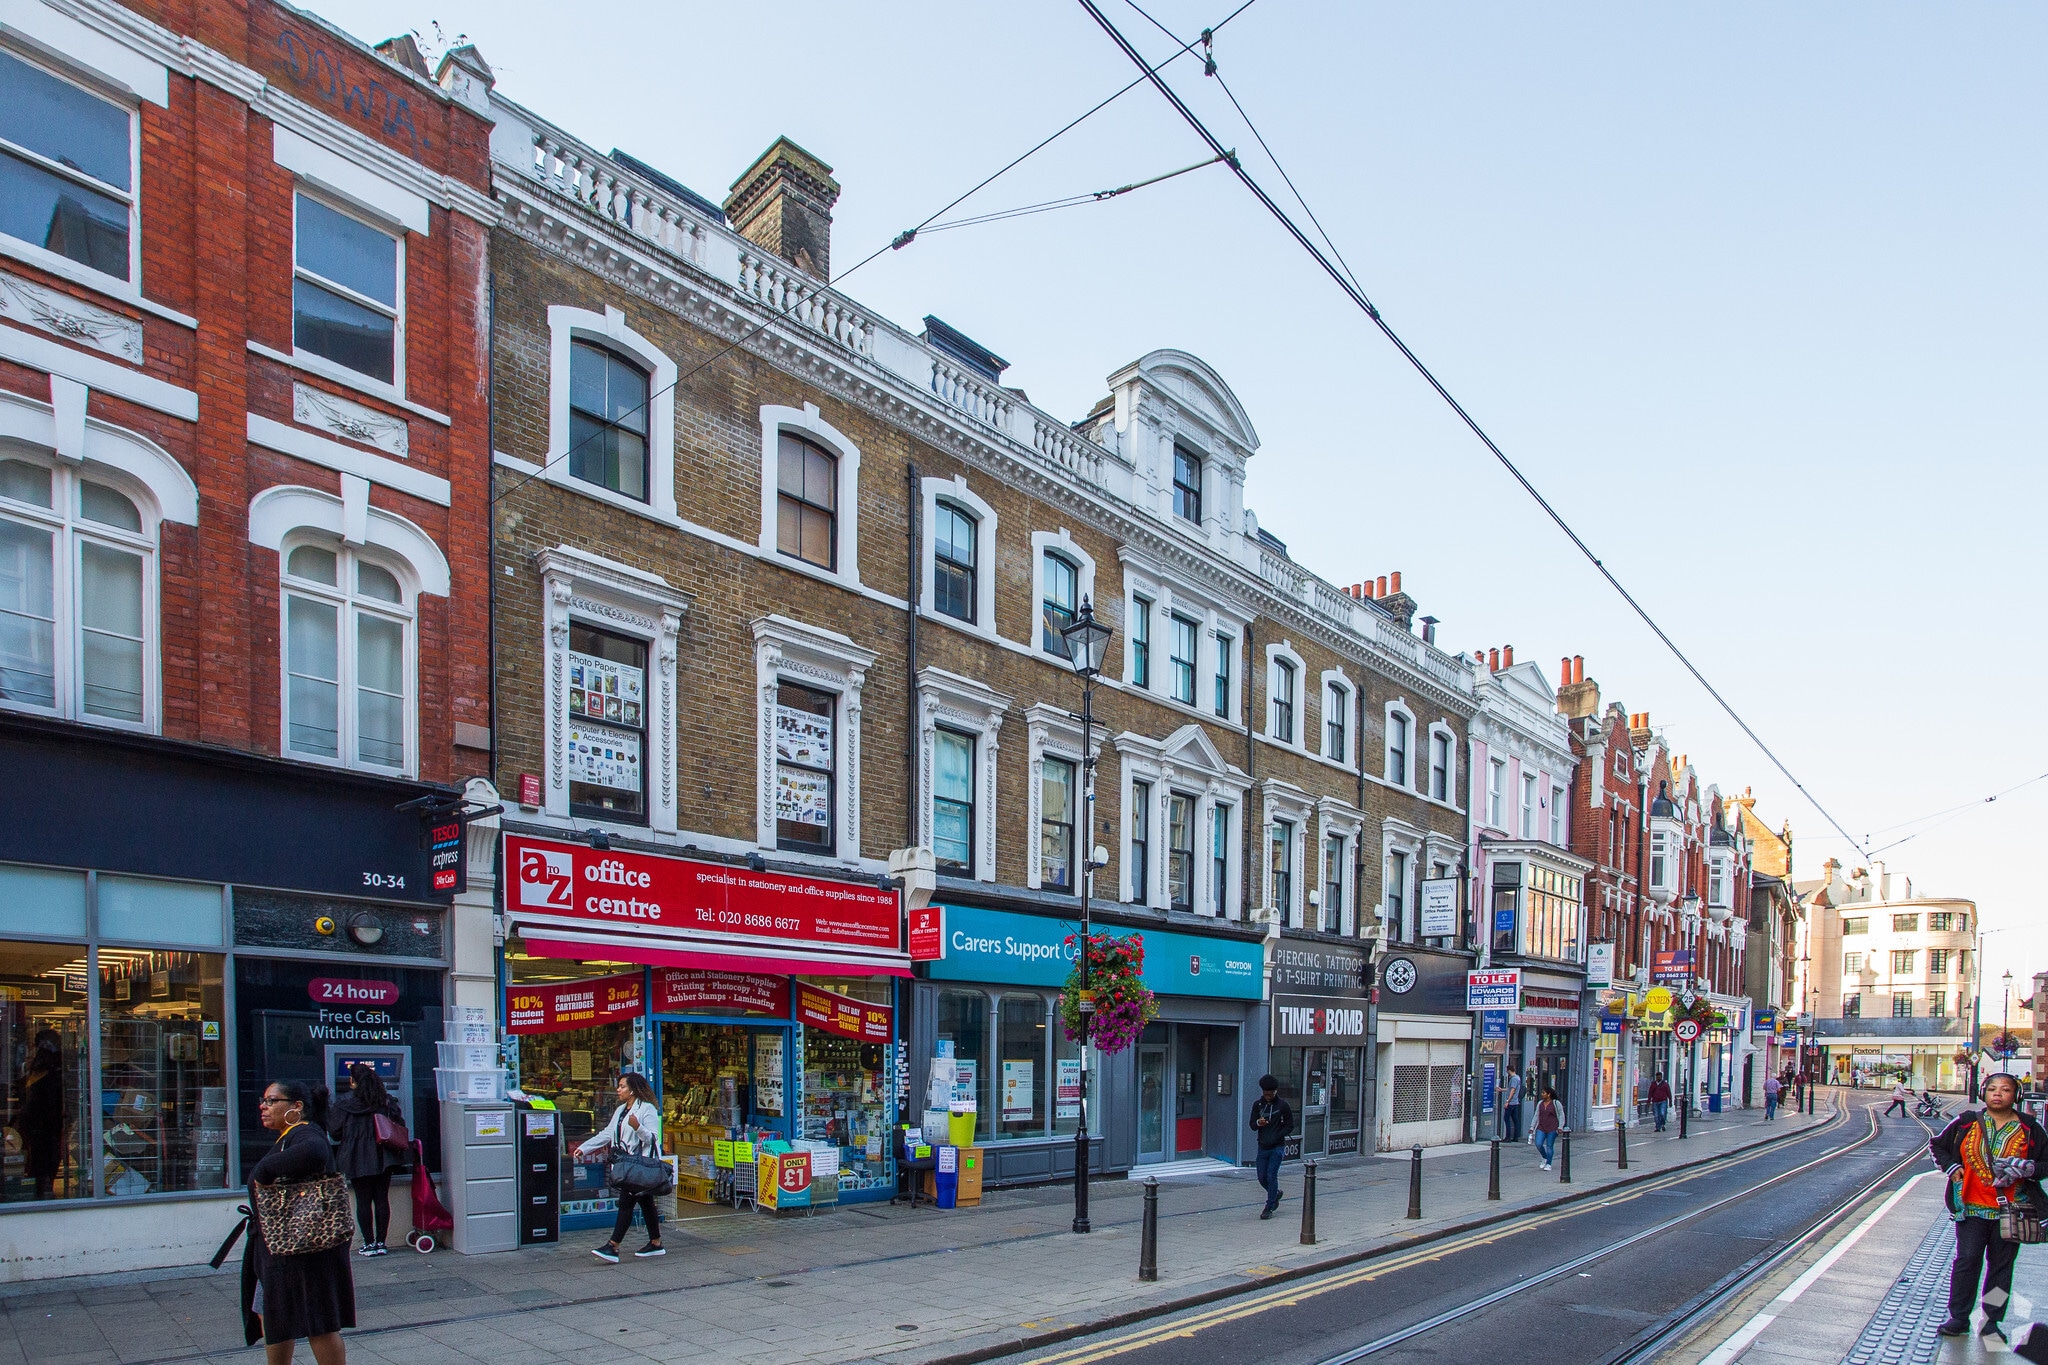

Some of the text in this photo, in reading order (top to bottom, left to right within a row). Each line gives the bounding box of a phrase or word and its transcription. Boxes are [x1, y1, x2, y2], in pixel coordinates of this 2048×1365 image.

[569, 653, 592, 667] Photo
[594, 660, 618, 674] Paper
[789, 708, 830, 726] Toners Available
[582, 732, 623, 747] Accessories
[601, 728, 607, 736] &
[608, 730, 638, 743] Electrical
[796, 770, 805, 778] Get
[816, 774, 826, 782] OFF
[432, 823, 459, 843] TESCO
[432, 850, 459, 869] express
[362, 872, 406, 889] 30-34
[444, 874, 455, 884] Cash
[585, 859, 651, 888] office
[696, 871, 893, 905] specialist in stationery and office supplies since 1988
[585, 896, 661, 920] centre
[695, 908, 800, 931] Tel: 020 8686 6677
[815, 918, 829, 926] Web:
[815, 926, 831, 934] Email:
[952, 930, 1060, 961] Carers Support
[1225, 959, 1252, 971] CROYDON
[1325, 954, 1362, 973] TATTOOS
[665, 970, 777, 989] Office and Stationery Supplies
[1276, 968, 1362, 989] & T-SHIRT PRINTING
[1475, 975, 1512, 984] TO LET
[322, 983, 387, 1000] 24 hour
[607, 983, 639, 1001] 3 FOR 2
[672, 981, 771, 997] Printing Photocopy Fax
[1471, 987, 1514, 995] EDWARDS
[511, 995, 544, 1010] 10%
[555, 991, 594, 1003] PRINTER INK
[607, 1002, 621, 1011] FILES
[626, 998, 639, 1009] PENS
[667, 992, 776, 1010] Rubber Stamps Laminating
[802, 991, 832, 1008] WHOLESALE
[1684, 995, 1693, 1004] 25
[555, 999, 595, 1012] CARTRIDGES
[801, 998, 832, 1015] DISCOUNTS
[838, 1003, 860, 1016] NEXT DAY
[319, 1008, 391, 1024] Free Cash
[510, 1010, 545, 1019] Student
[511, 1018, 544, 1026] Discount
[556, 1010, 595, 1022] AND TONERS
[805, 1009, 828, 1023] AVAILABLE
[838, 1012, 861, 1026] DELIVERY
[866, 1010, 887, 1024] 10%
[1279, 1007, 1364, 1036] TIME BOMB
[308, 1025, 401, 1041] Withdrawals
[838, 1020, 860, 1033] SERVICE
[865, 1021, 887, 1031] Student
[865, 1028, 887, 1037] Discount
[1679, 1025, 1697, 1035] 20
[1284, 1144, 1299, 1156] OOS
[1329, 1138, 1356, 1150] PIERCING
[786, 1159, 805, 1167] ONLY
[759, 1158, 777, 1203] STATIONERY
[783, 1168, 804, 1187] £1
